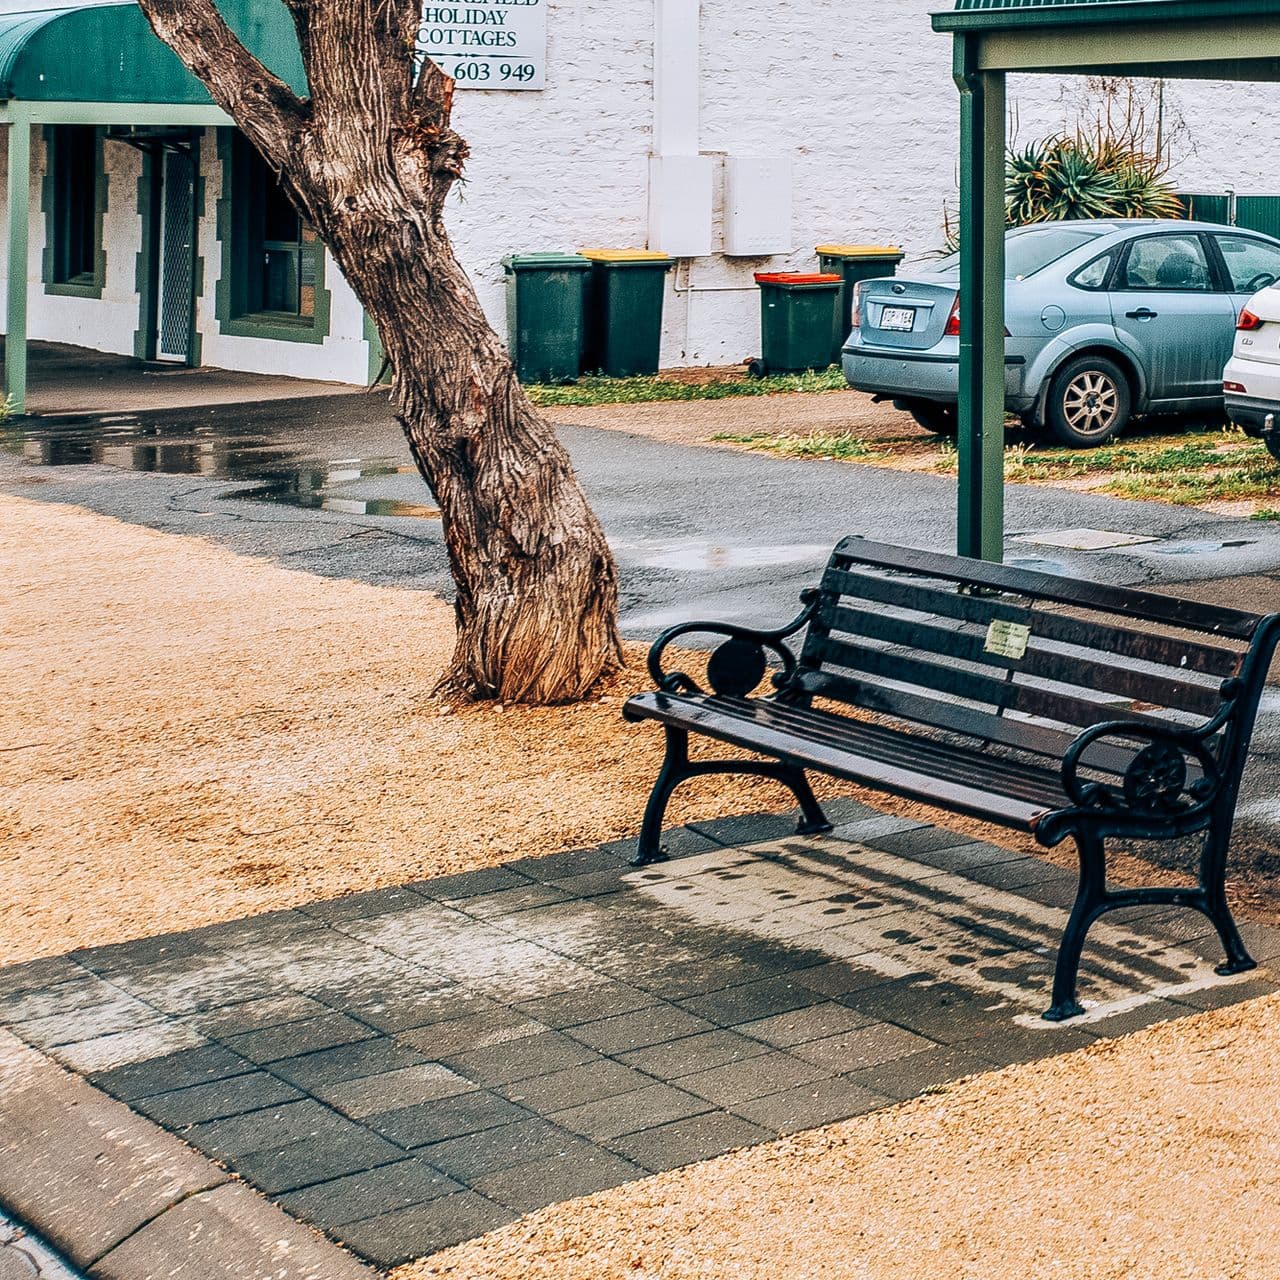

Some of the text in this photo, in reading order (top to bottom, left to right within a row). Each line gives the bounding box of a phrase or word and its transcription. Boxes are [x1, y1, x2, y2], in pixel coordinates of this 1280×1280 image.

[425, 8, 509, 25] HOLIDAY
[416, 28, 517, 47] COTTAGES
[454, 62, 490, 81] 603
[500, 63, 535, 82] 949
